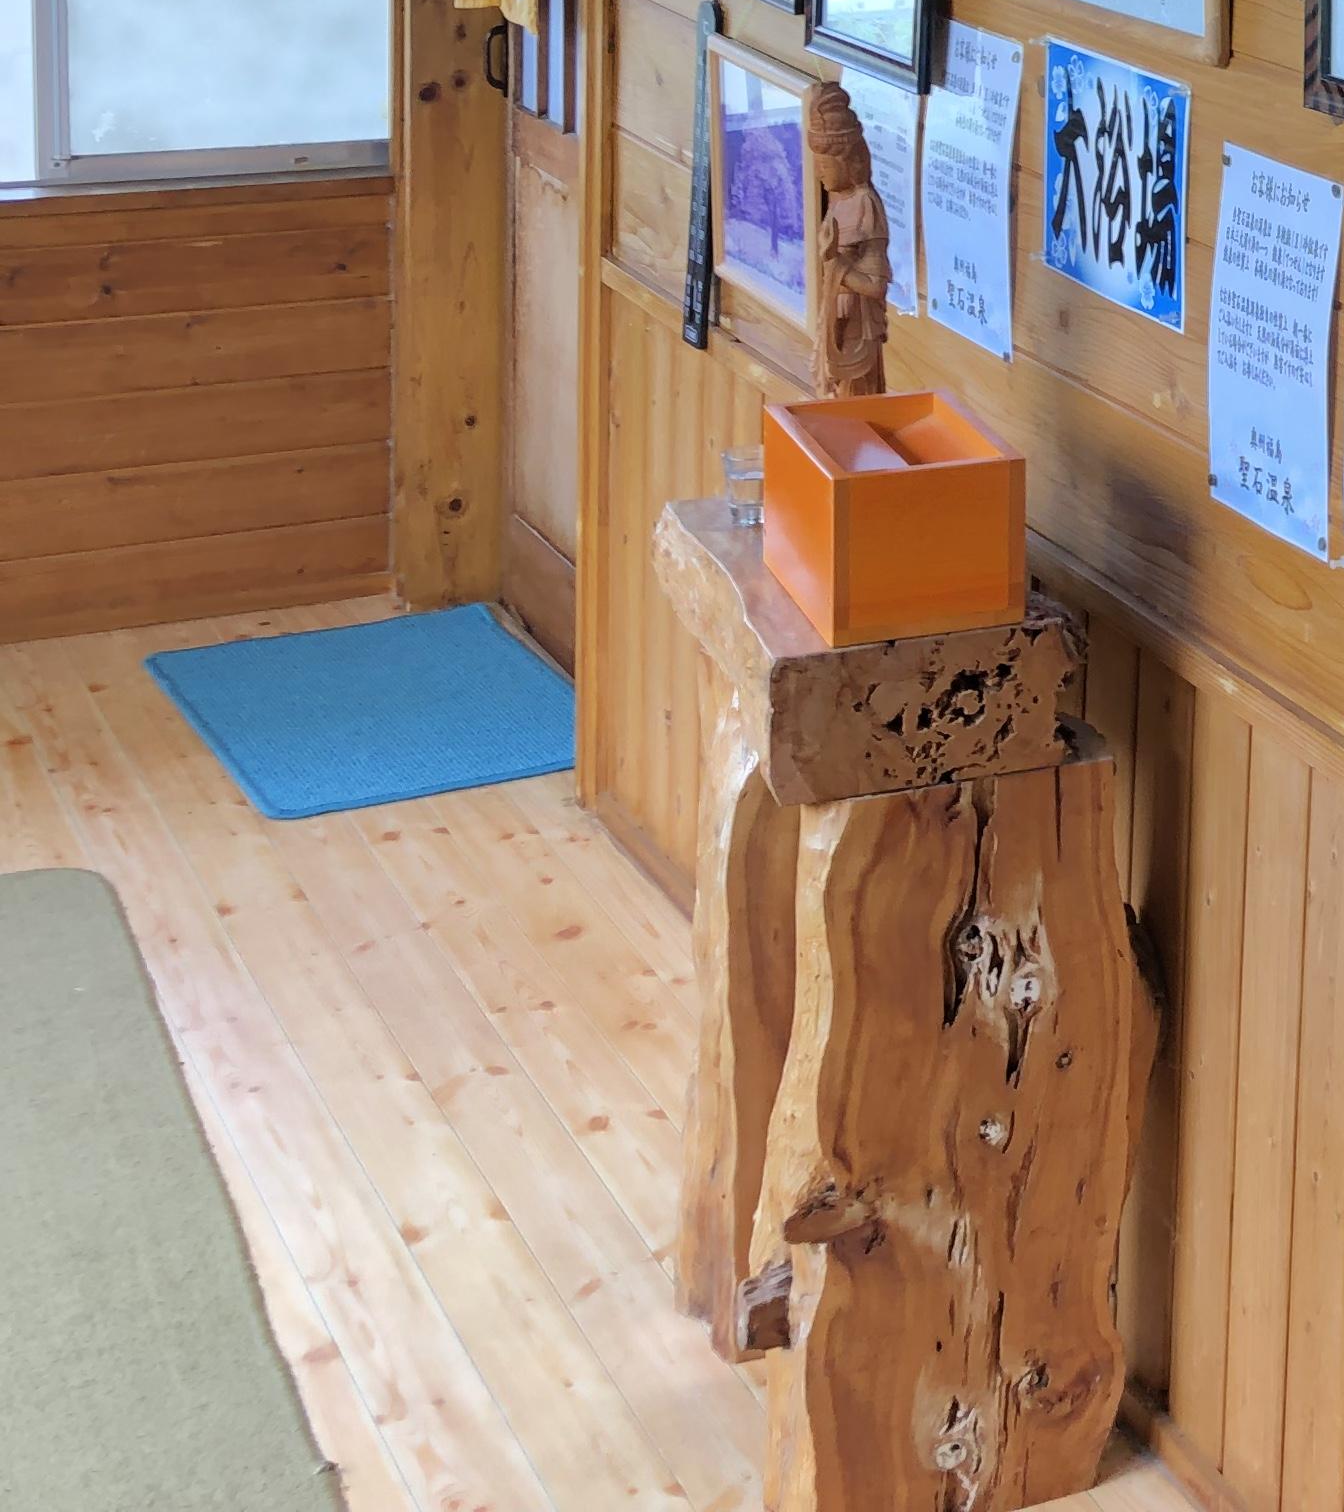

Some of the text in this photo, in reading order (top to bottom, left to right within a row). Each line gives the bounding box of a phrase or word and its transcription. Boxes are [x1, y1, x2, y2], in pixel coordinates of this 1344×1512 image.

[1250, 169, 1311, 213] お客様にお知らせ
[1239, 455, 1295, 515] 聖石温泉
